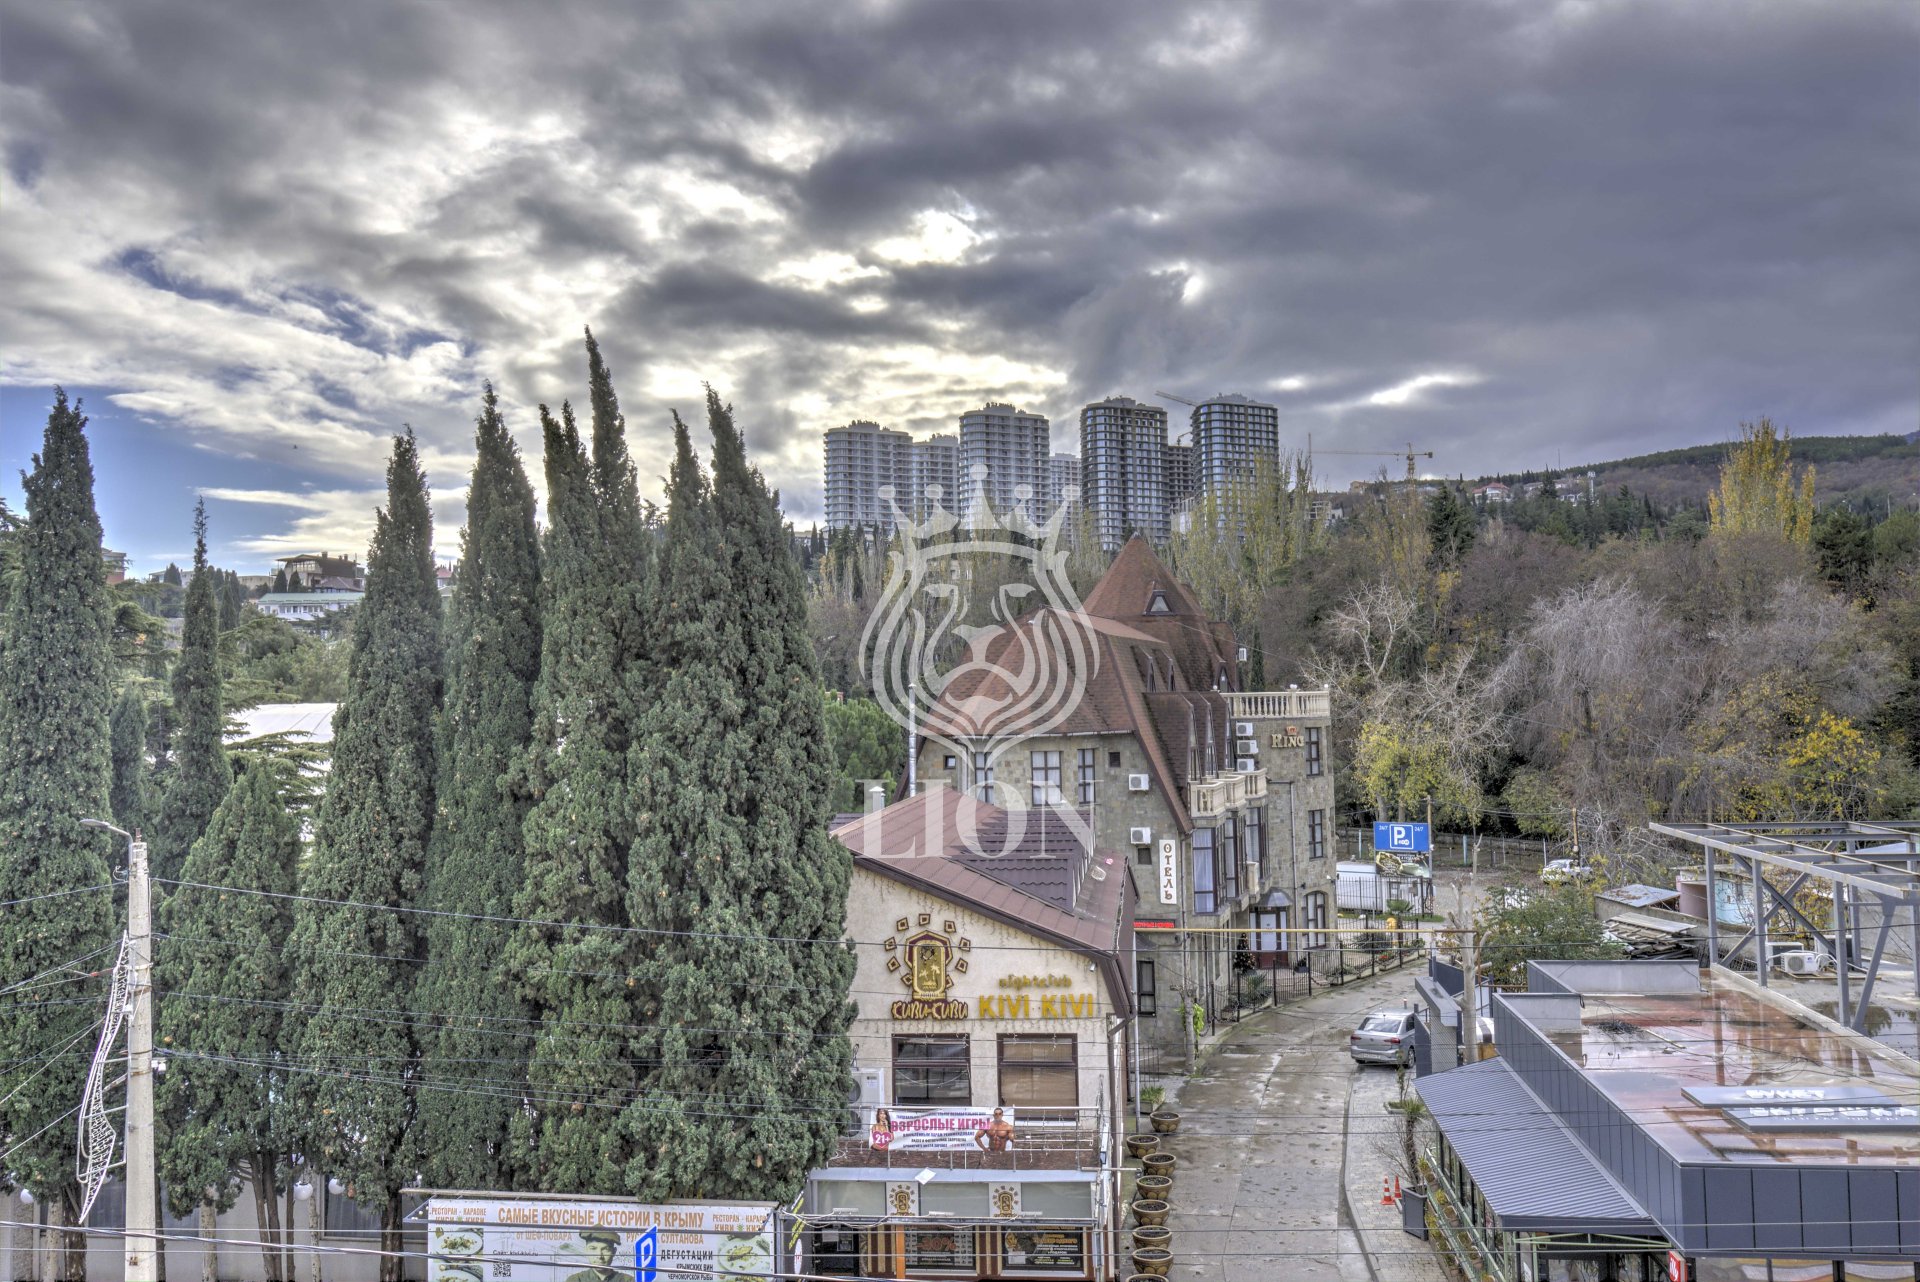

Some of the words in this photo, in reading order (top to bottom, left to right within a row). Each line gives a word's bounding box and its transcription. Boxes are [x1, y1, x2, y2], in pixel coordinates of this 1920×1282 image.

[1163, 843, 1173, 900] ОТЕЛЬ
[979, 994, 1030, 1019] KIVI
[1042, 993, 1093, 1018] KIVI
[890, 1118, 955, 1132] ВЗРОСЛЫЕ
[875, 1133, 890, 1144] 21+
[498, 1207, 538, 1224] САМЫЕ
[541, 1209, 594, 1225] ВКУСНЫЕ
[598, 1210, 650, 1226] ИСТОРИИ
[653, 1212, 661, 1227] В
[664, 1212, 704, 1229] КРЫМУ
[525, 1231, 572, 1241] ШЕФ-ПОВАРА
[661, 1234, 704, 1245] СУЛТАНОВА
[661, 1249, 713, 1262] ДЕГУСТАЦИИ
